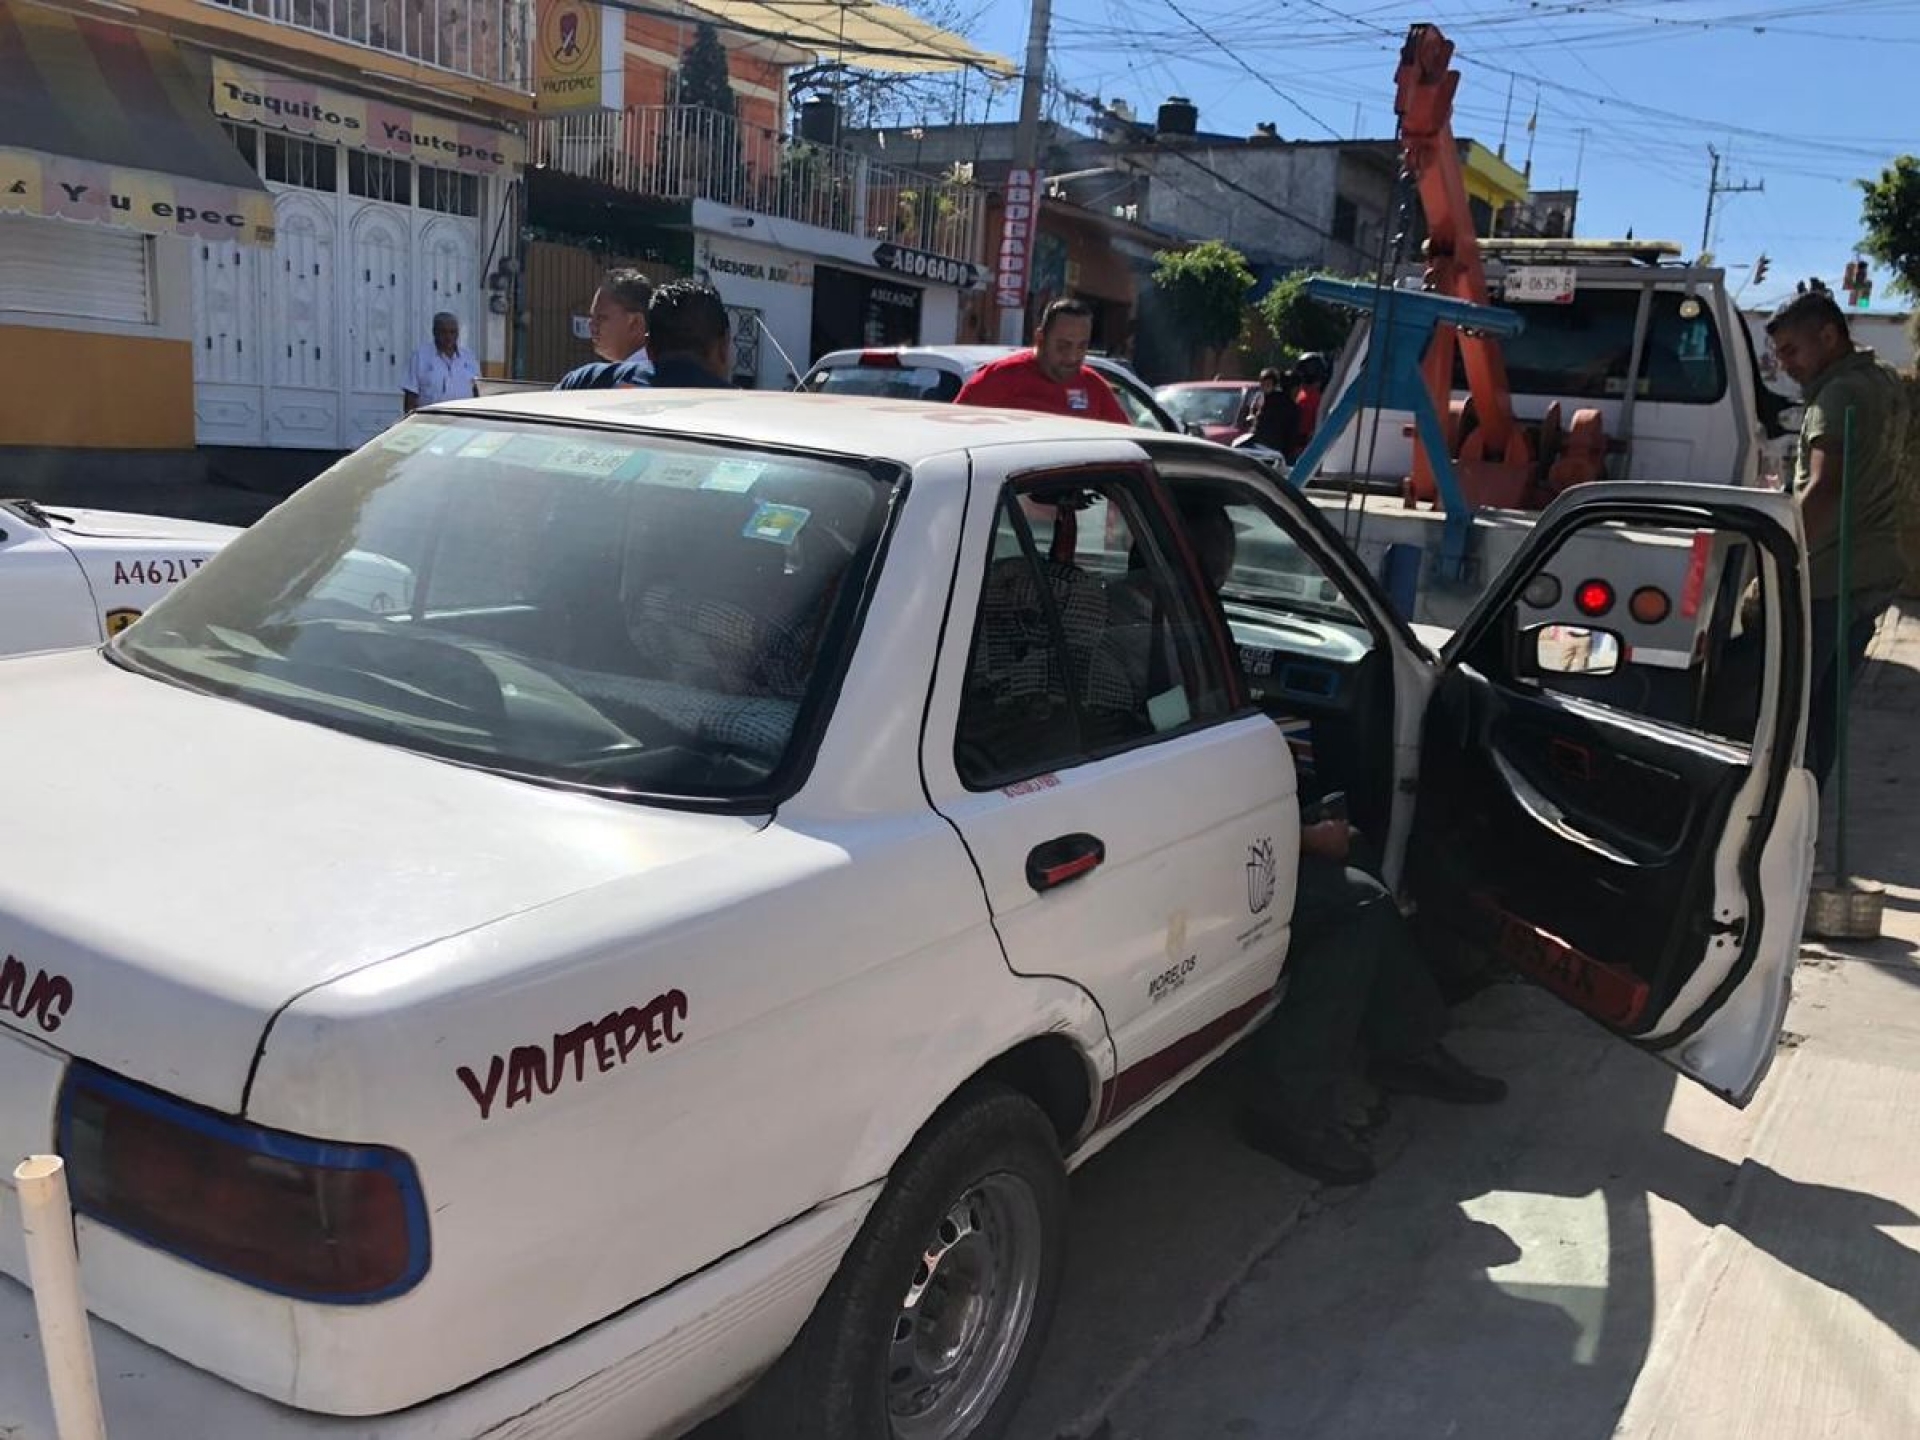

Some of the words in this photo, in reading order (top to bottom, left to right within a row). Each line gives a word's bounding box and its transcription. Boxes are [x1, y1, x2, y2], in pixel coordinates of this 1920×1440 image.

[222, 81, 361, 130] Taquitos
[381, 120, 506, 165] Yautepec
[997, 169, 1031, 306] ABOGADOS
[455, 987, 689, 1121] YAUTEPEC
